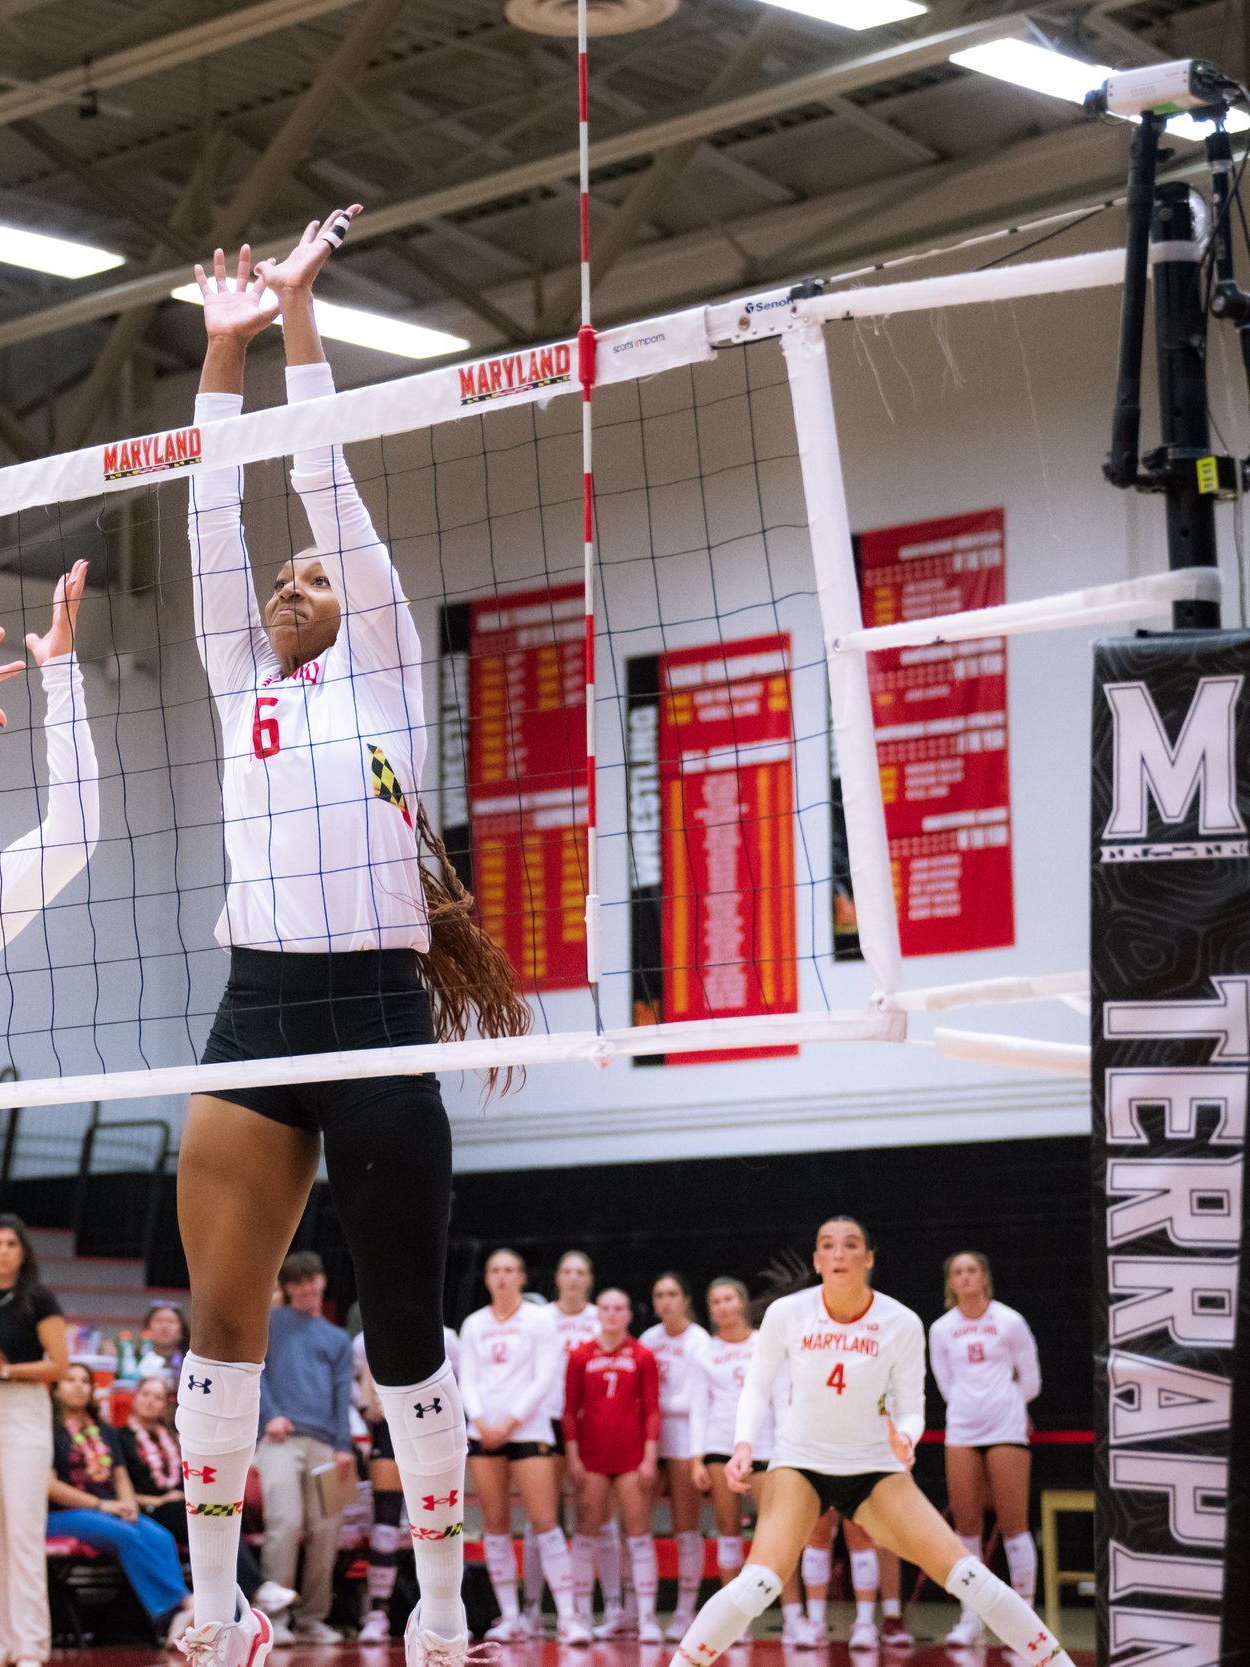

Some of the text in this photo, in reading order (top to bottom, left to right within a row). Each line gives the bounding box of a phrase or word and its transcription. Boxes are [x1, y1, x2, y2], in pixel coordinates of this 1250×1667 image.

[458, 343, 571, 399] MARYLAND
[103, 427, 202, 474] MARYLAND
[253, 697, 280, 760] 6
[1101, 675, 1247, 841] M
[801, 1332, 879, 1358] MARYLAND
[603, 1372, 618, 1398] 7
[826, 1362, 846, 1395] 4
